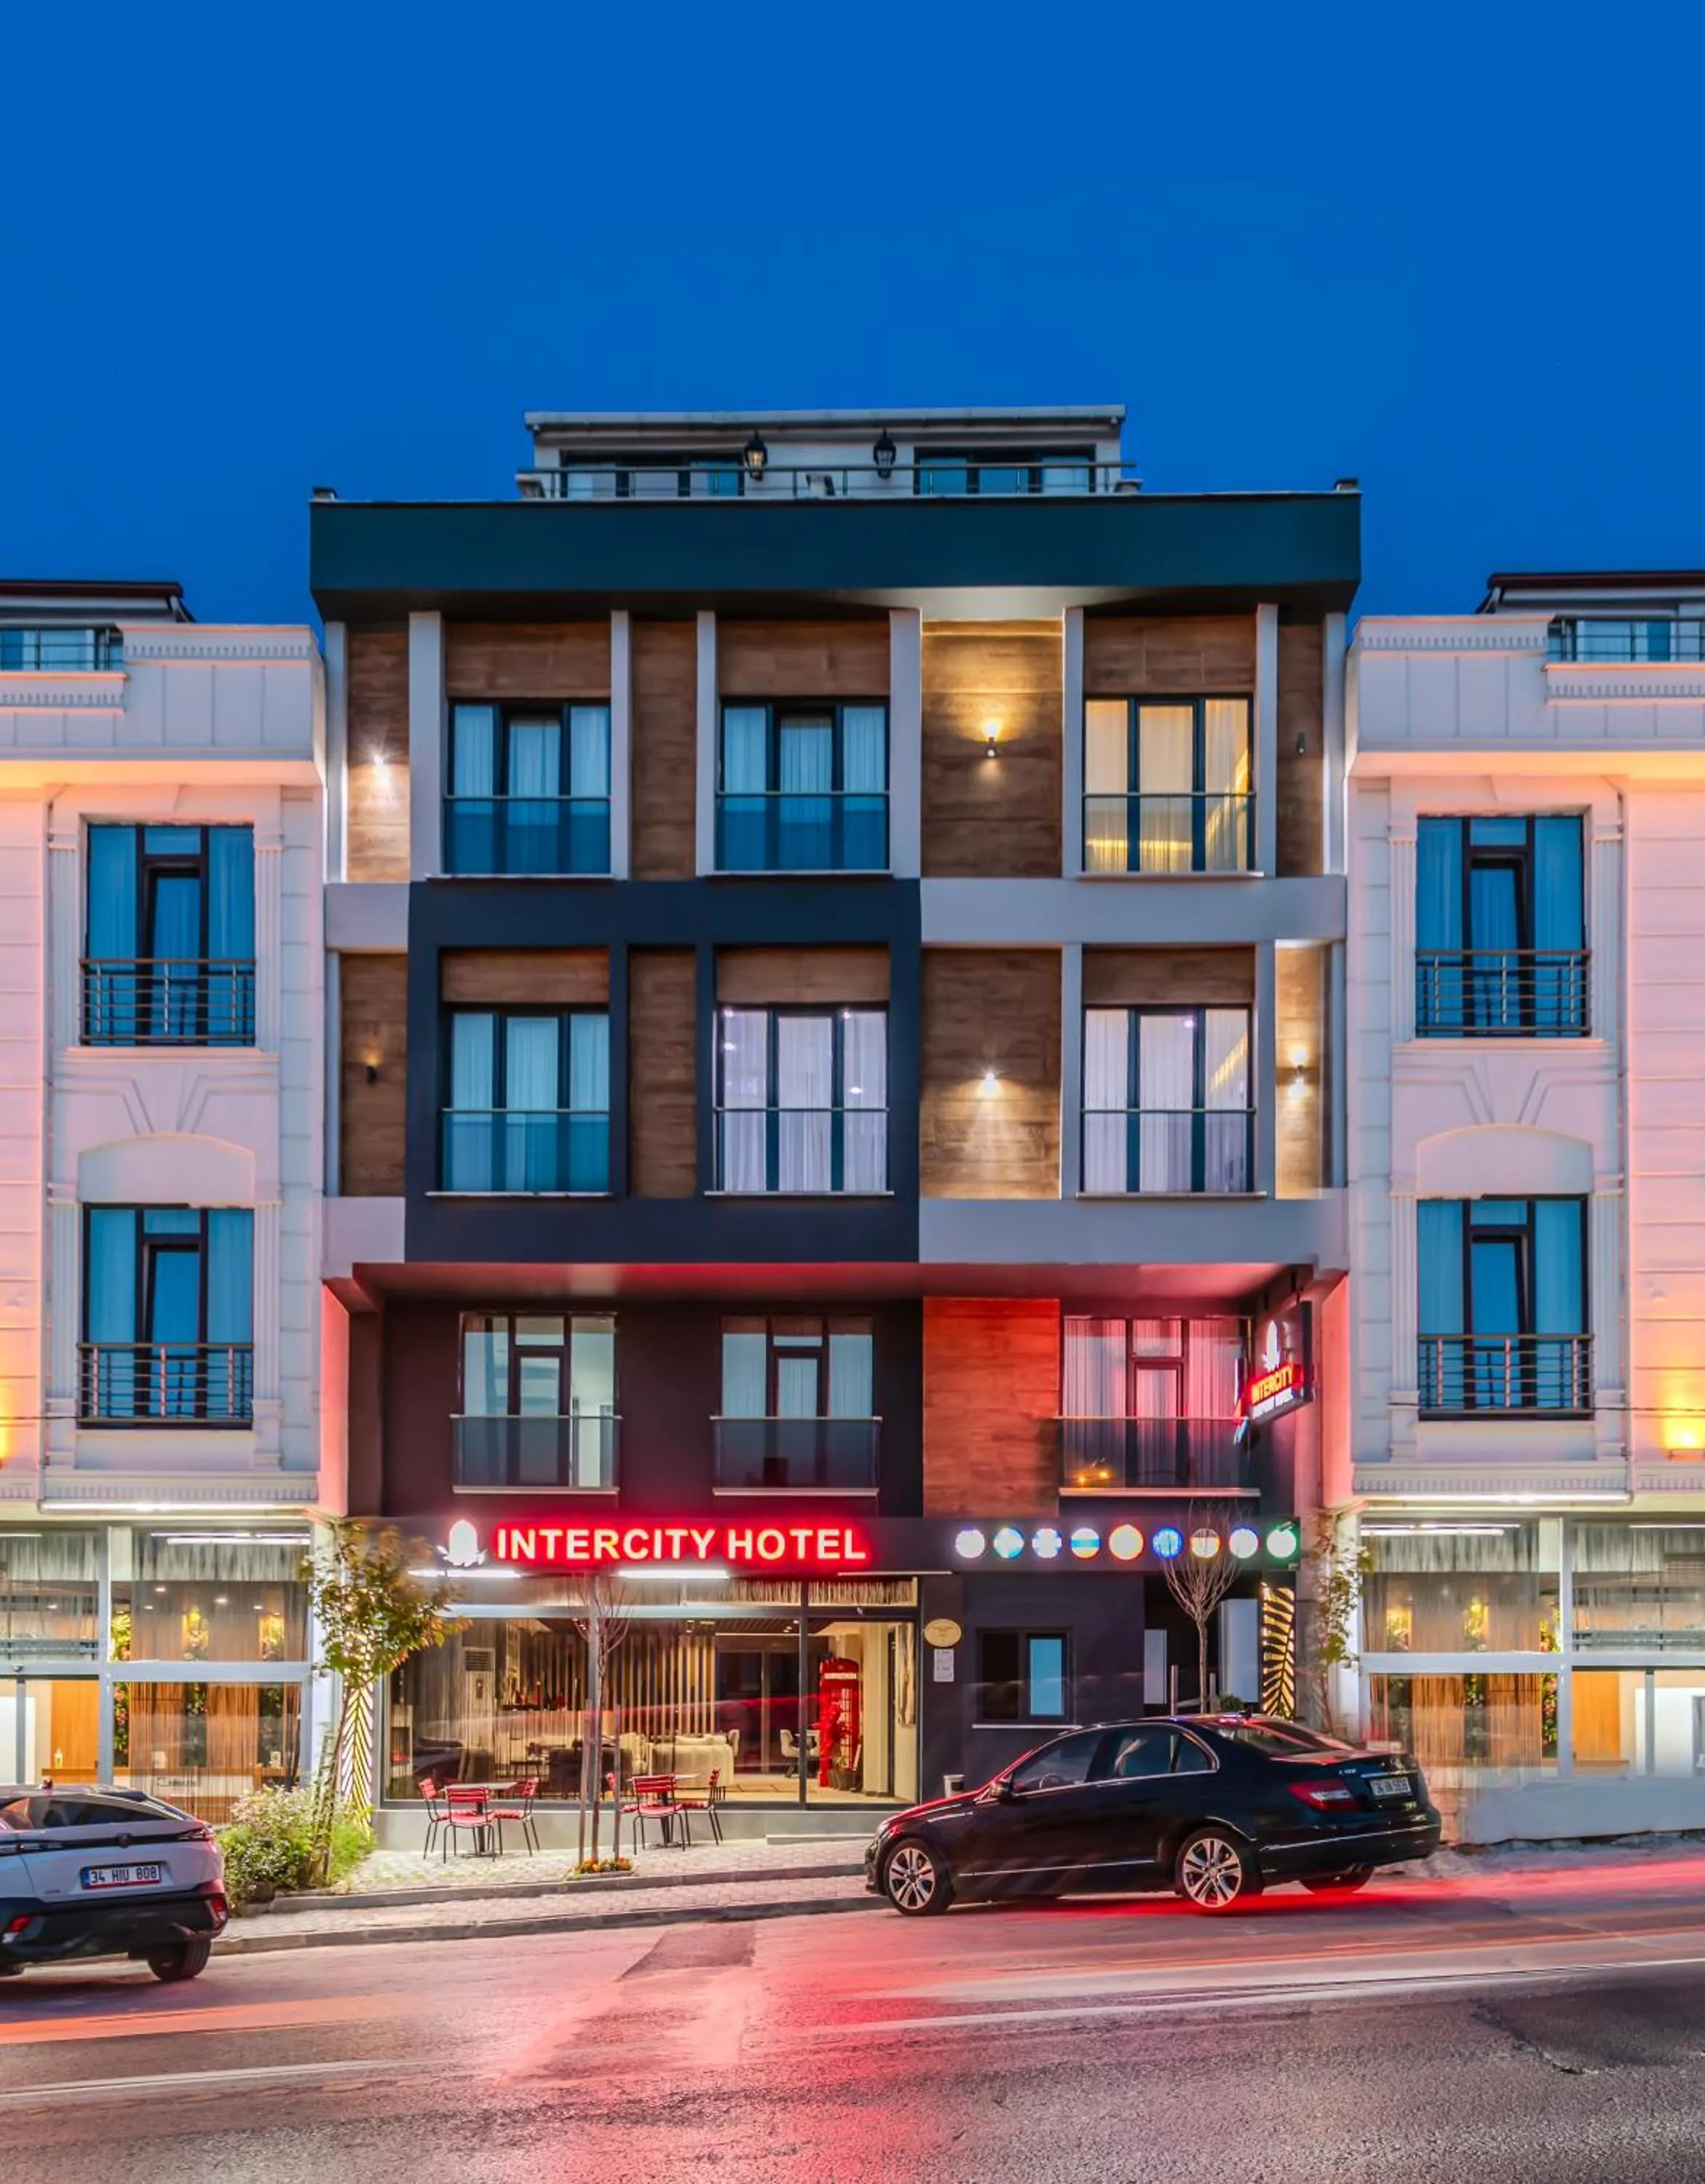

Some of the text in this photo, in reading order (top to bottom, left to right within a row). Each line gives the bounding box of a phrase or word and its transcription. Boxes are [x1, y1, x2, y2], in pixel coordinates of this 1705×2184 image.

[1251, 1366, 1293, 1404] INTERCITY
[497, 1528, 866, 1560] INTERCITY HOTEL
[91, 1870, 106, 1883] 34
